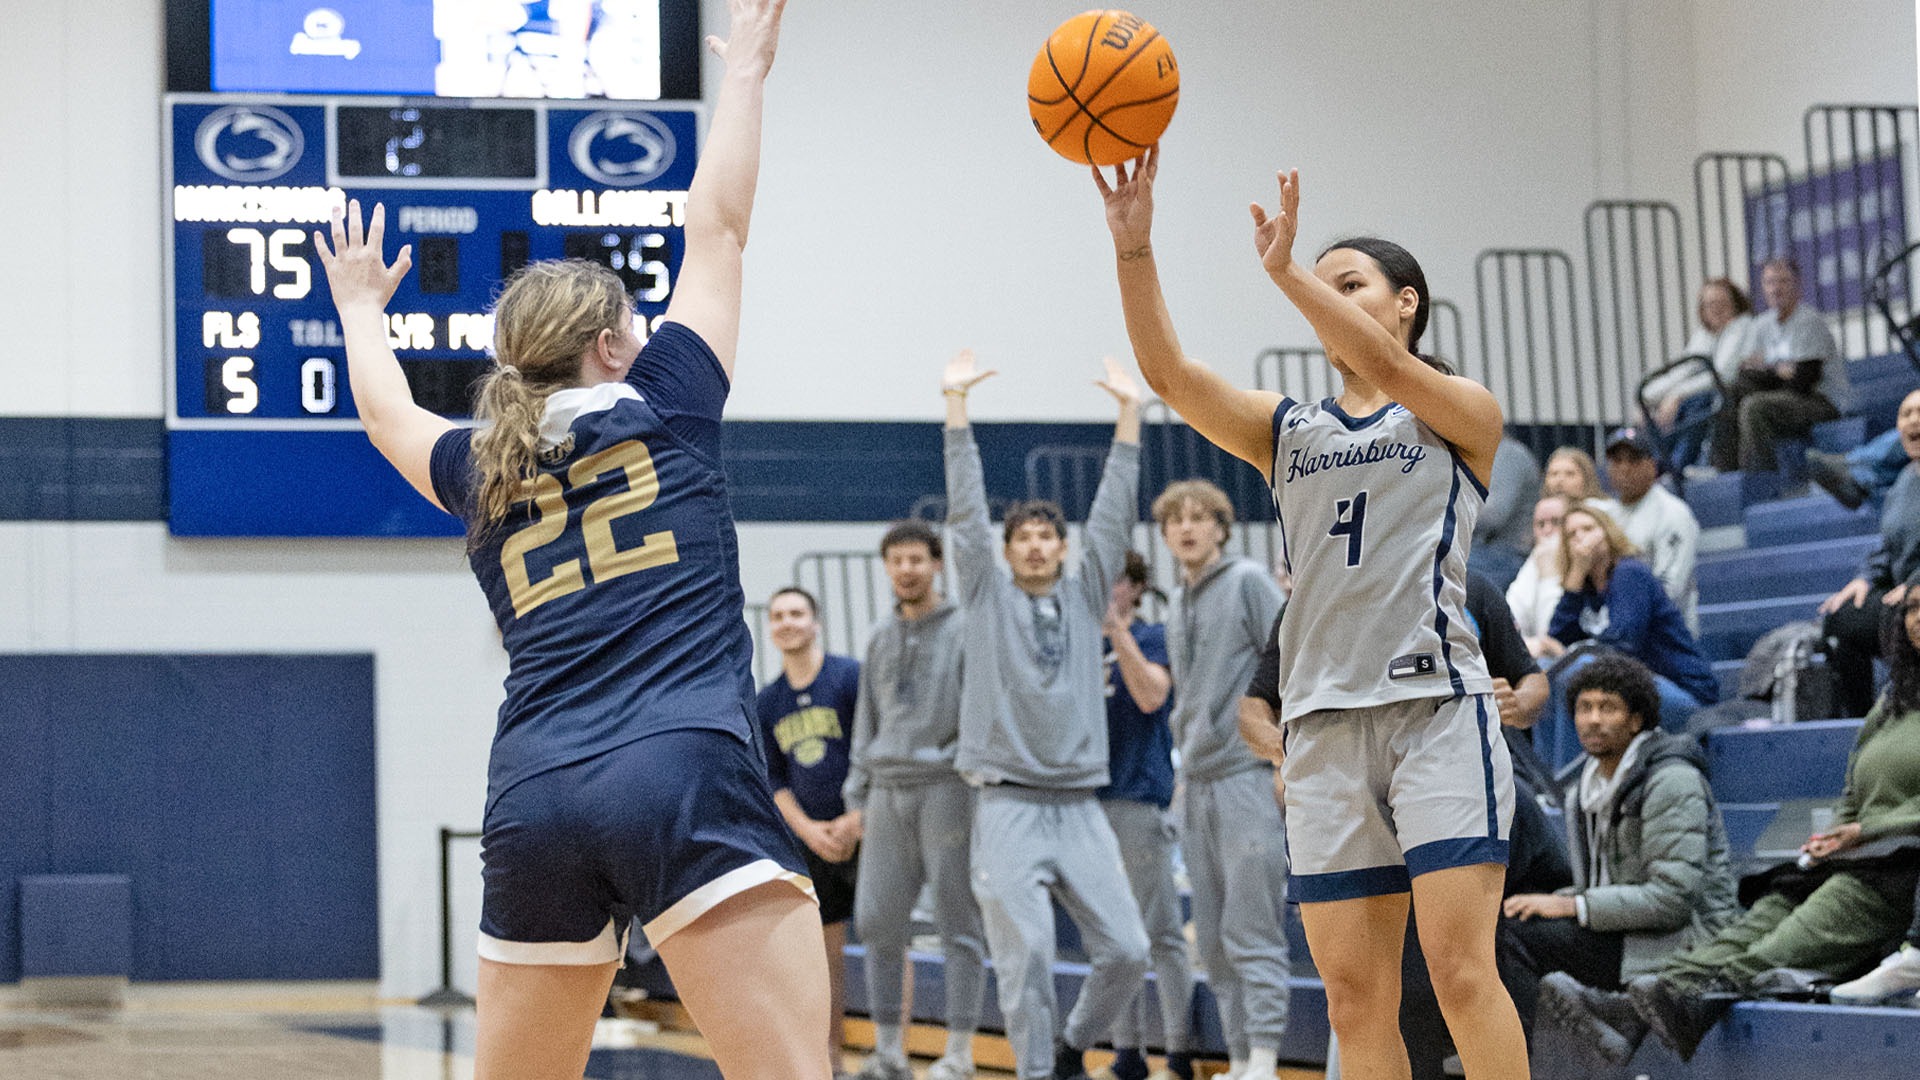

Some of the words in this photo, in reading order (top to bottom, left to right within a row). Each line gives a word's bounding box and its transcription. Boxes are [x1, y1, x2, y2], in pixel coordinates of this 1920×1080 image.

[227, 228, 311, 299] 75
[222, 356, 258, 413] 5
[301, 357, 335, 413] 0
[1286, 439, 1427, 483] Harrisburg
[488, 439, 679, 620] 22
[1328, 489, 1368, 568] 4
[1421, 658, 1430, 669] S
